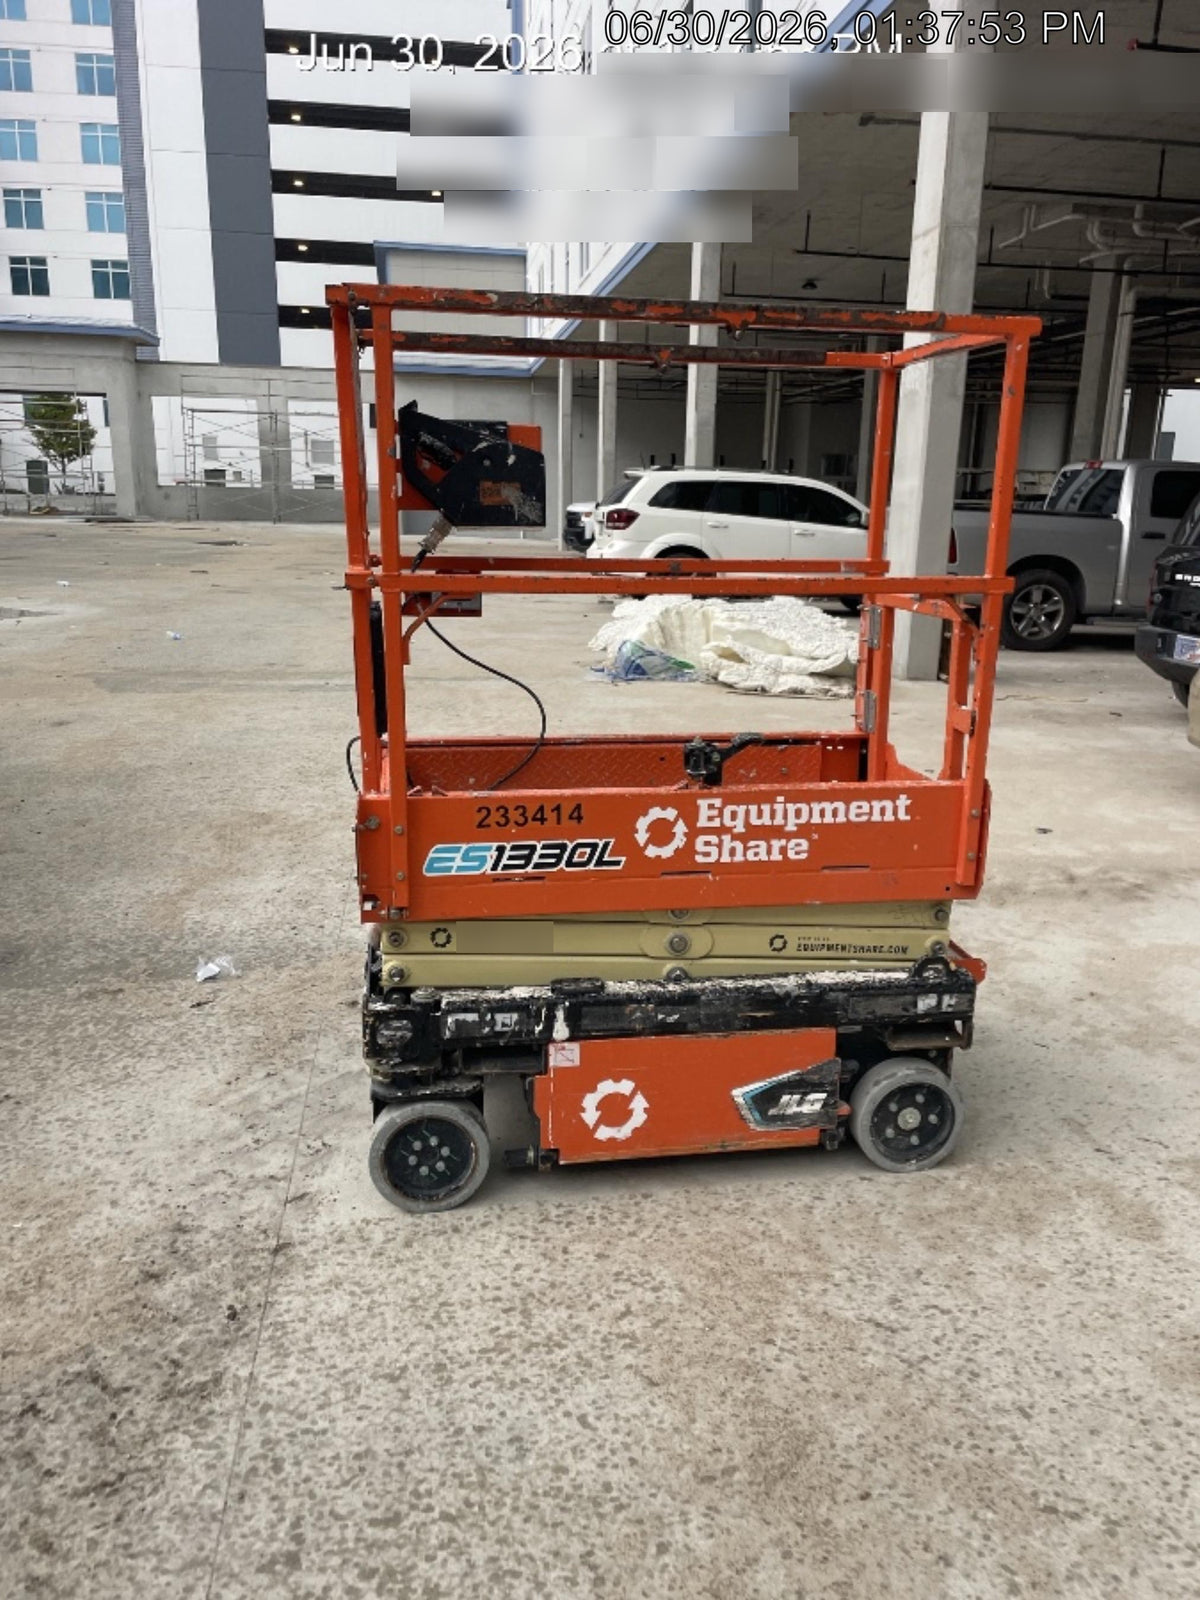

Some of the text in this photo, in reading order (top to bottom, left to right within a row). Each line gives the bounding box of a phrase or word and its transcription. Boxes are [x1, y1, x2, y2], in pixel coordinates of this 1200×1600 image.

[475, 803, 584, 829] 233414
[696, 794, 913, 833] Equipment
[422, 838, 627, 877] ES1330L
[694, 834, 809, 863] Share
